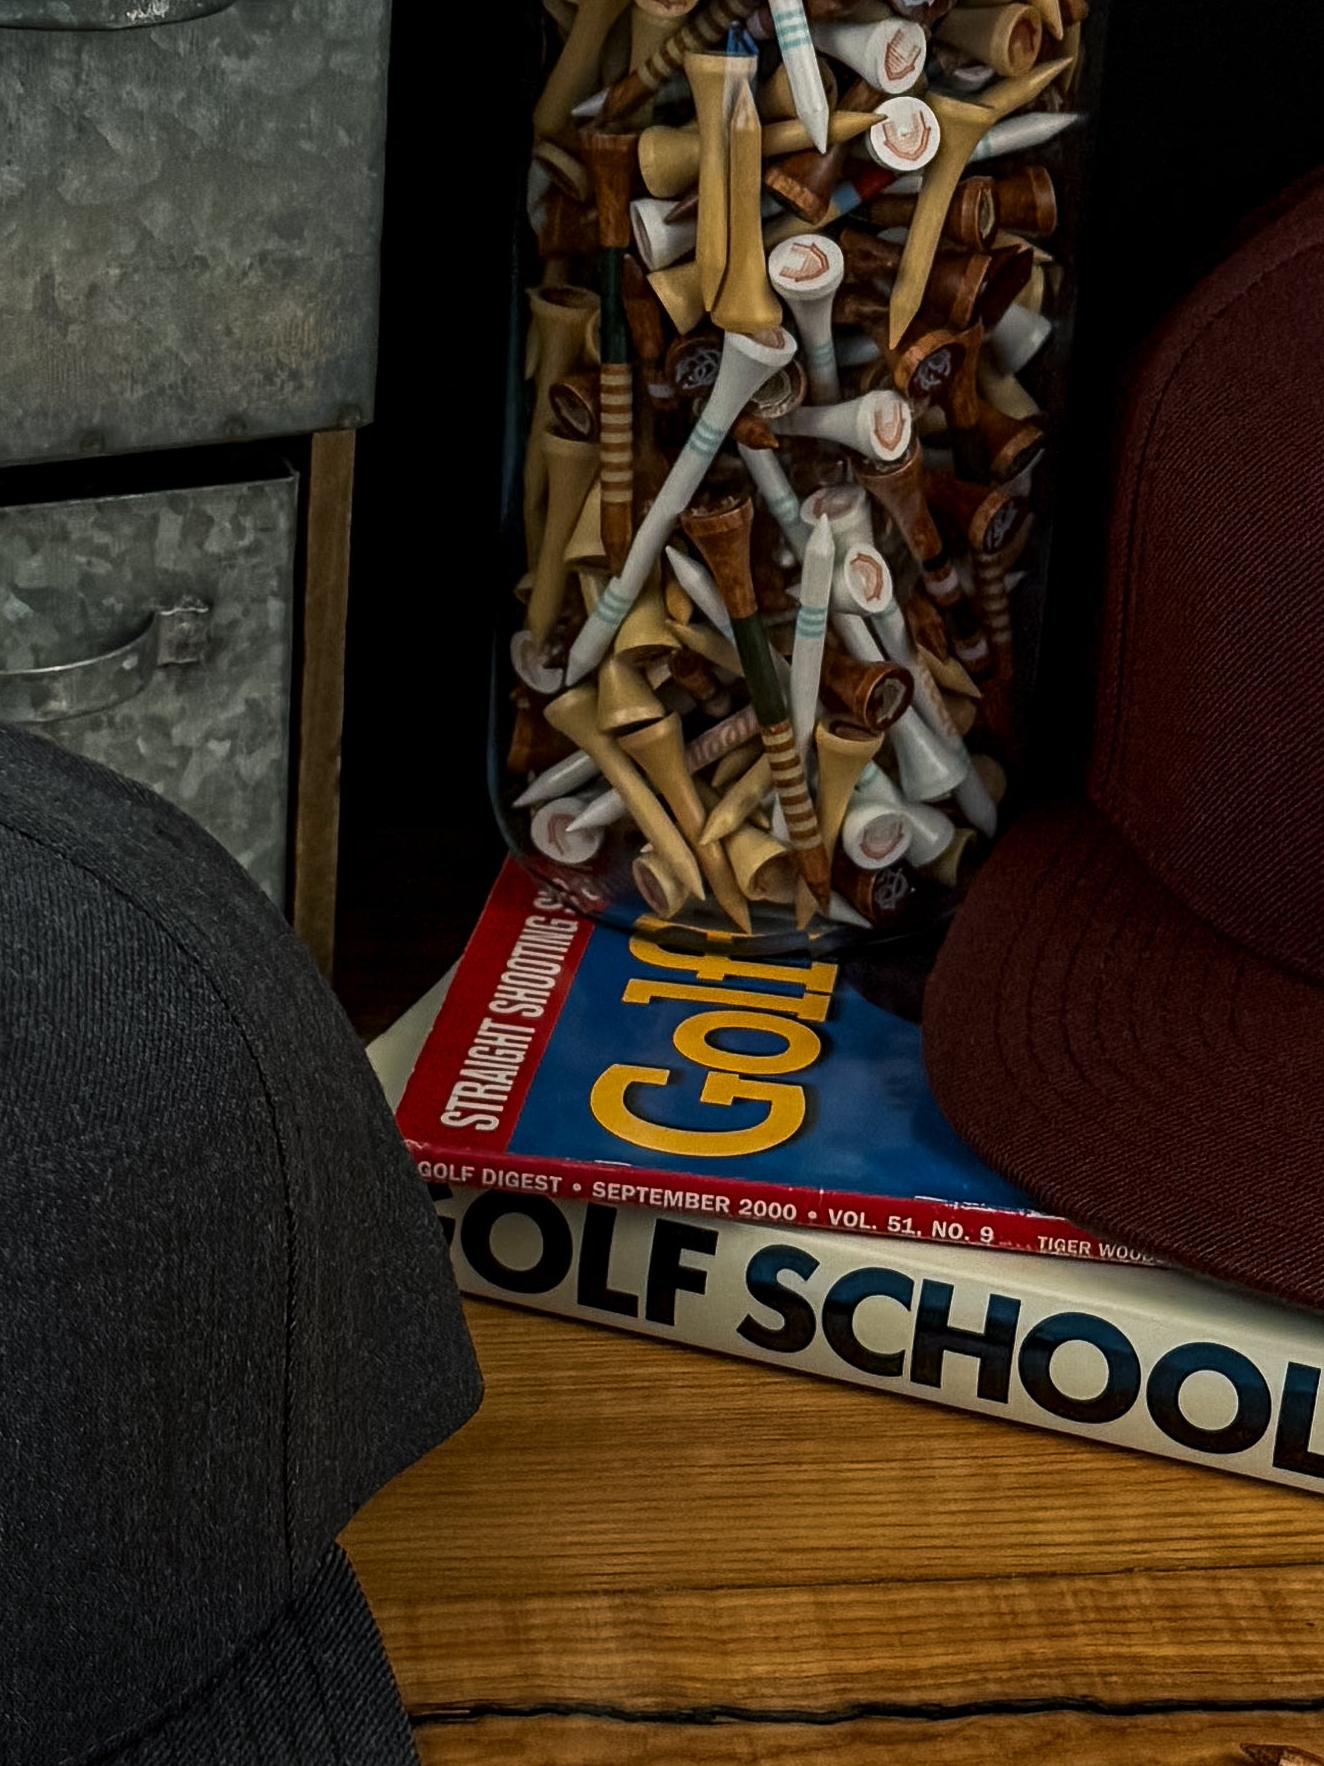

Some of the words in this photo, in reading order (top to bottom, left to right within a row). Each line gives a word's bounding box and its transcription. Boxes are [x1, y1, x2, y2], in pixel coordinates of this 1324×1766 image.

[440, 1017, 536, 1132] STRAIGHT
[488, 915, 579, 1019] SHOOTING
[590, 919, 839, 1157] Golf
[417, 1159, 475, 1182] GOLF
[481, 1167, 564, 1195] DIGEST
[592, 1181, 731, 1214] SEPTEMBER
[738, 1198, 798, 1221] 2000
[828, 1207, 877, 1232] VOL.
[930, 1219, 972, 1243] NO.
[979, 1224, 996, 1246] 9
[1037, 1235, 1092, 1256] TIGER
[429, 1182, 719, 1326] OLF
